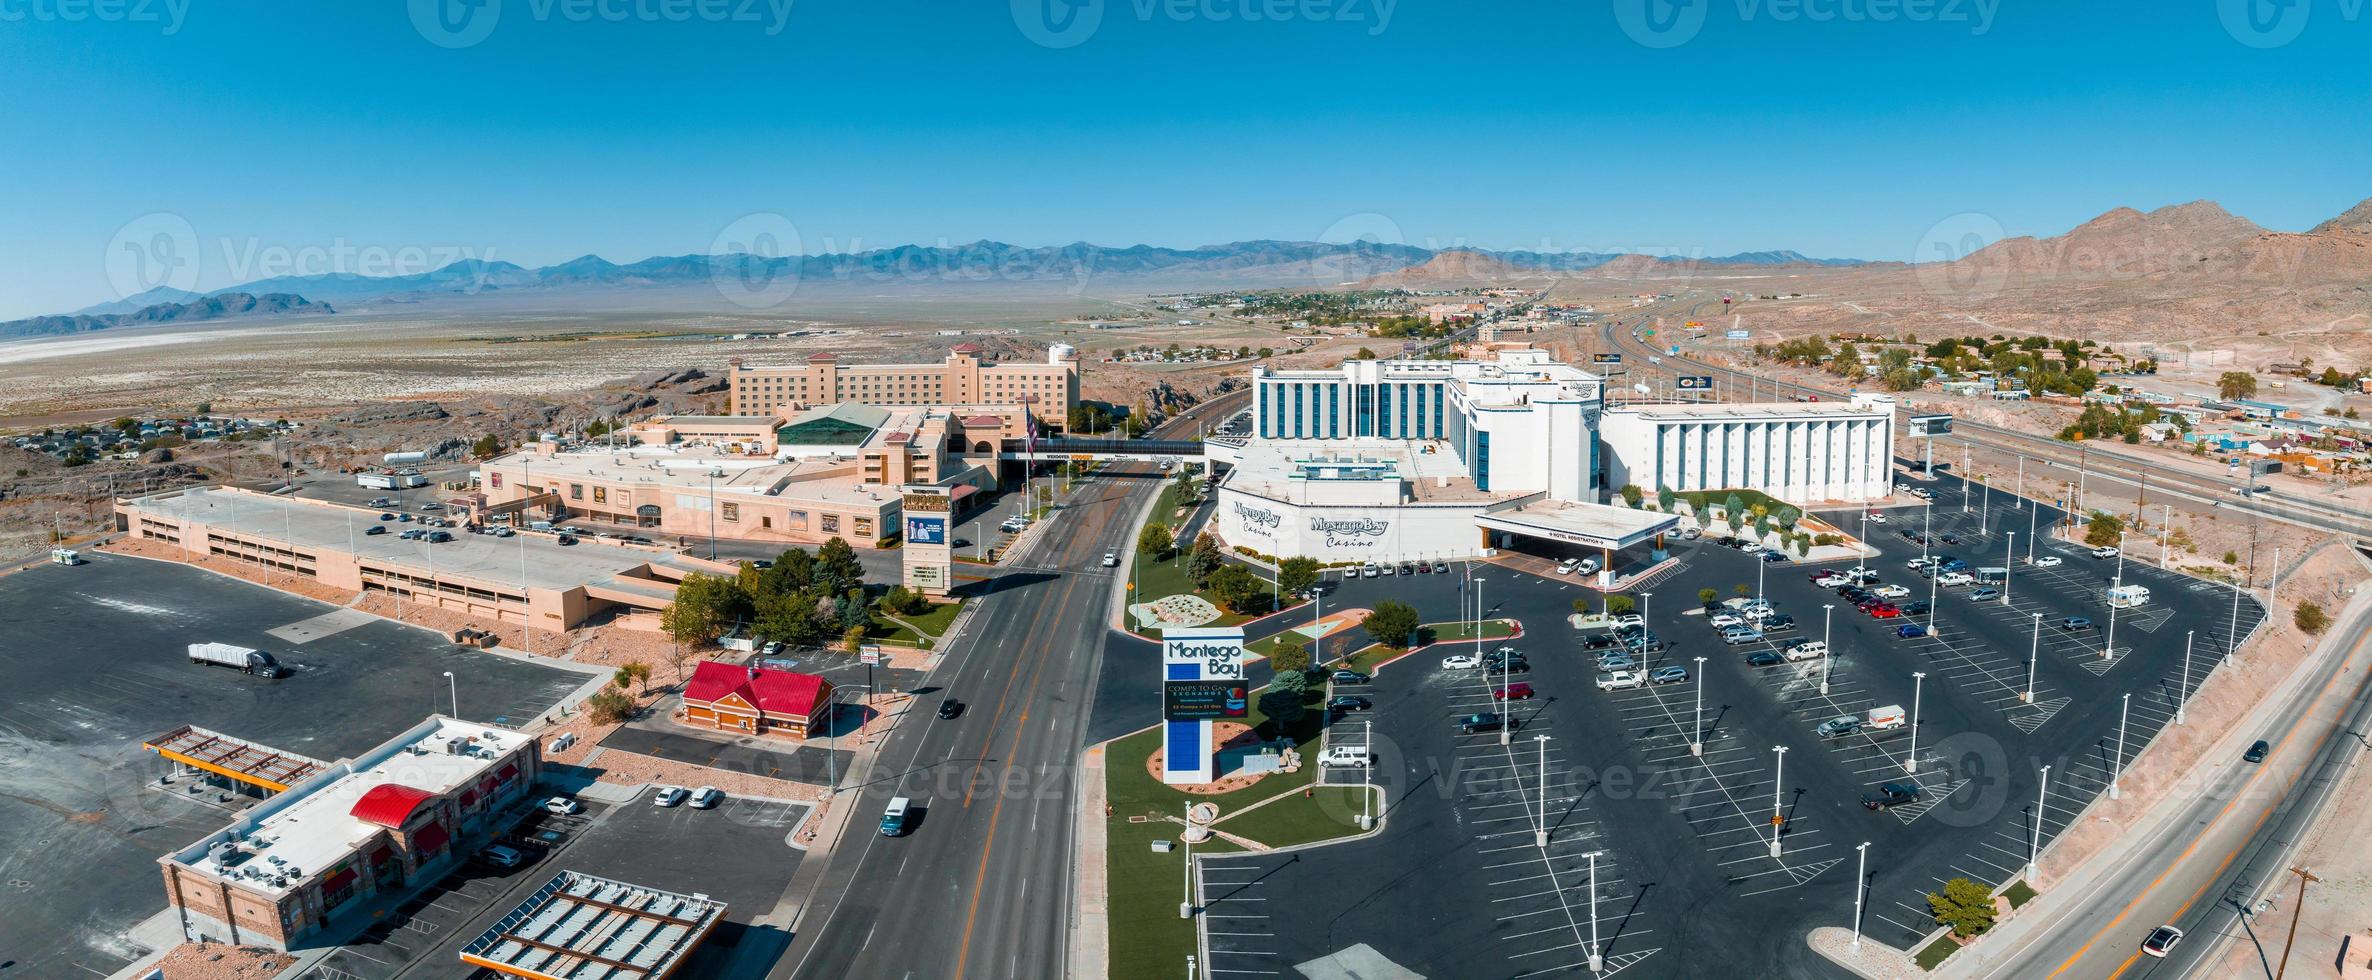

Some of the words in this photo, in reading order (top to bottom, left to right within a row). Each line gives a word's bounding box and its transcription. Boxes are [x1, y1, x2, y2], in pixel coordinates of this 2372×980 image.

[1243, 522, 1272, 538] Casino
[1326, 537, 1373, 548] Casino
[1568, 535, 1599, 544] REGISTRATION
[1169, 641, 1242, 662] Montego
[1208, 658, 1241, 679] Bay
